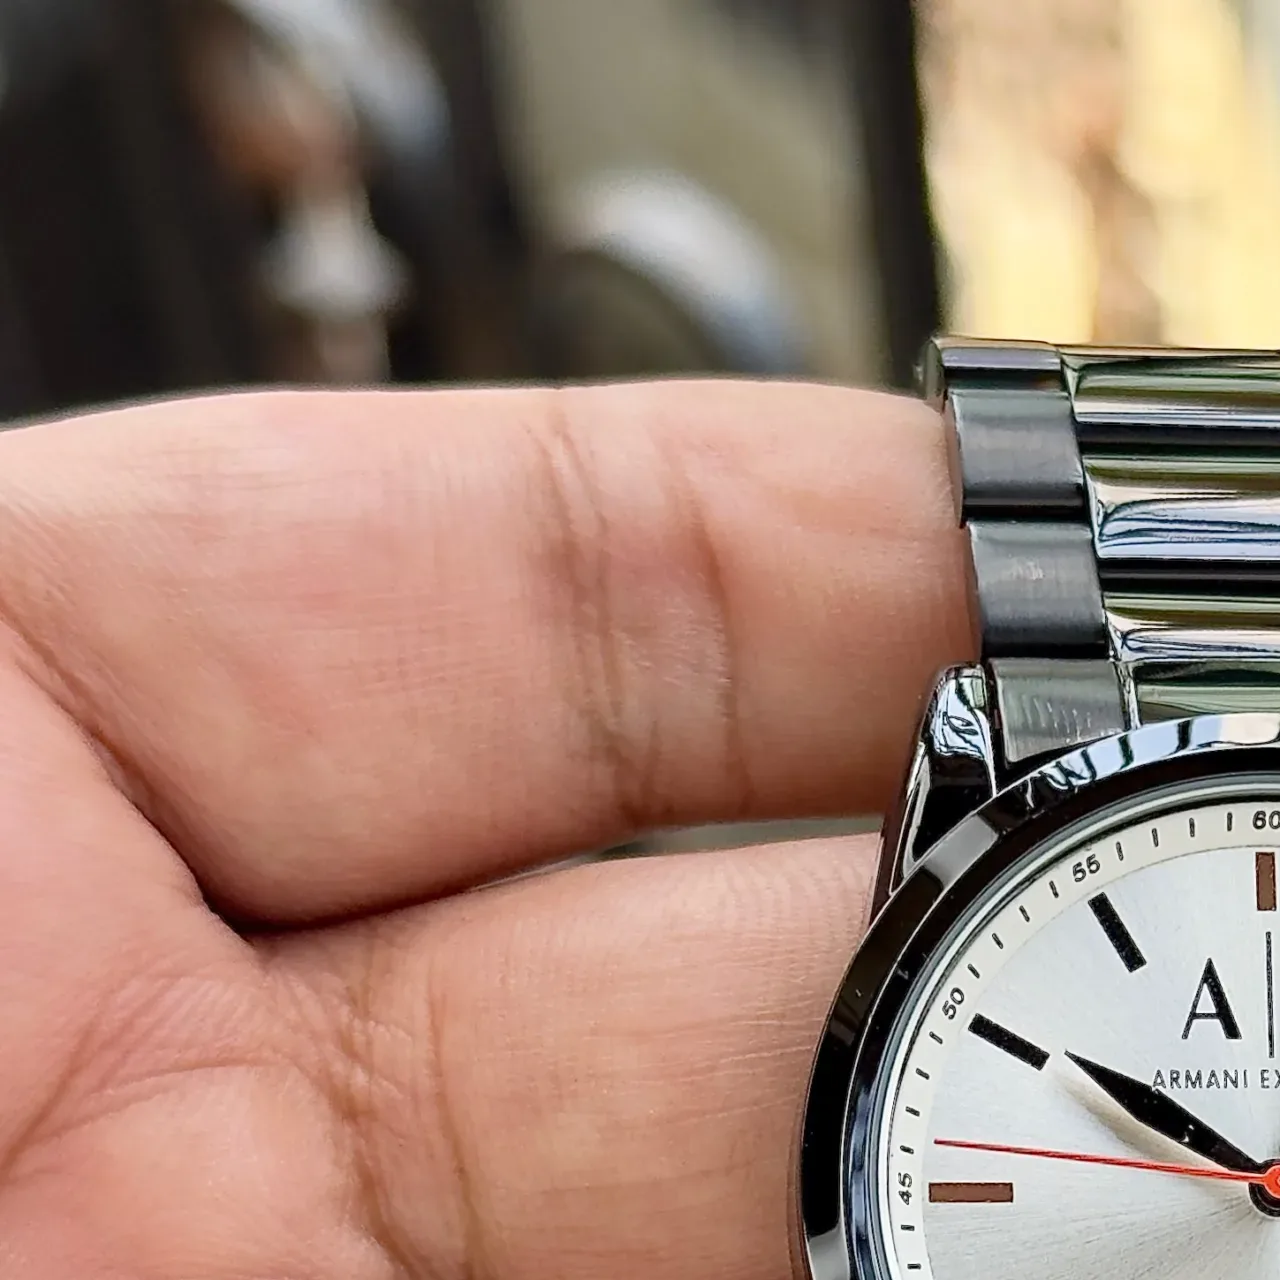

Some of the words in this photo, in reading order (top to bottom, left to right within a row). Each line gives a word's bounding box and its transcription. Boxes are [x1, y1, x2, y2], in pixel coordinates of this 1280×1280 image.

[1072, 853, 1101, 883] 55
[942, 987, 965, 1020] 50
[1152, 1068, 1249, 1090] ARMANI
[897, 1172, 913, 1206] 45
